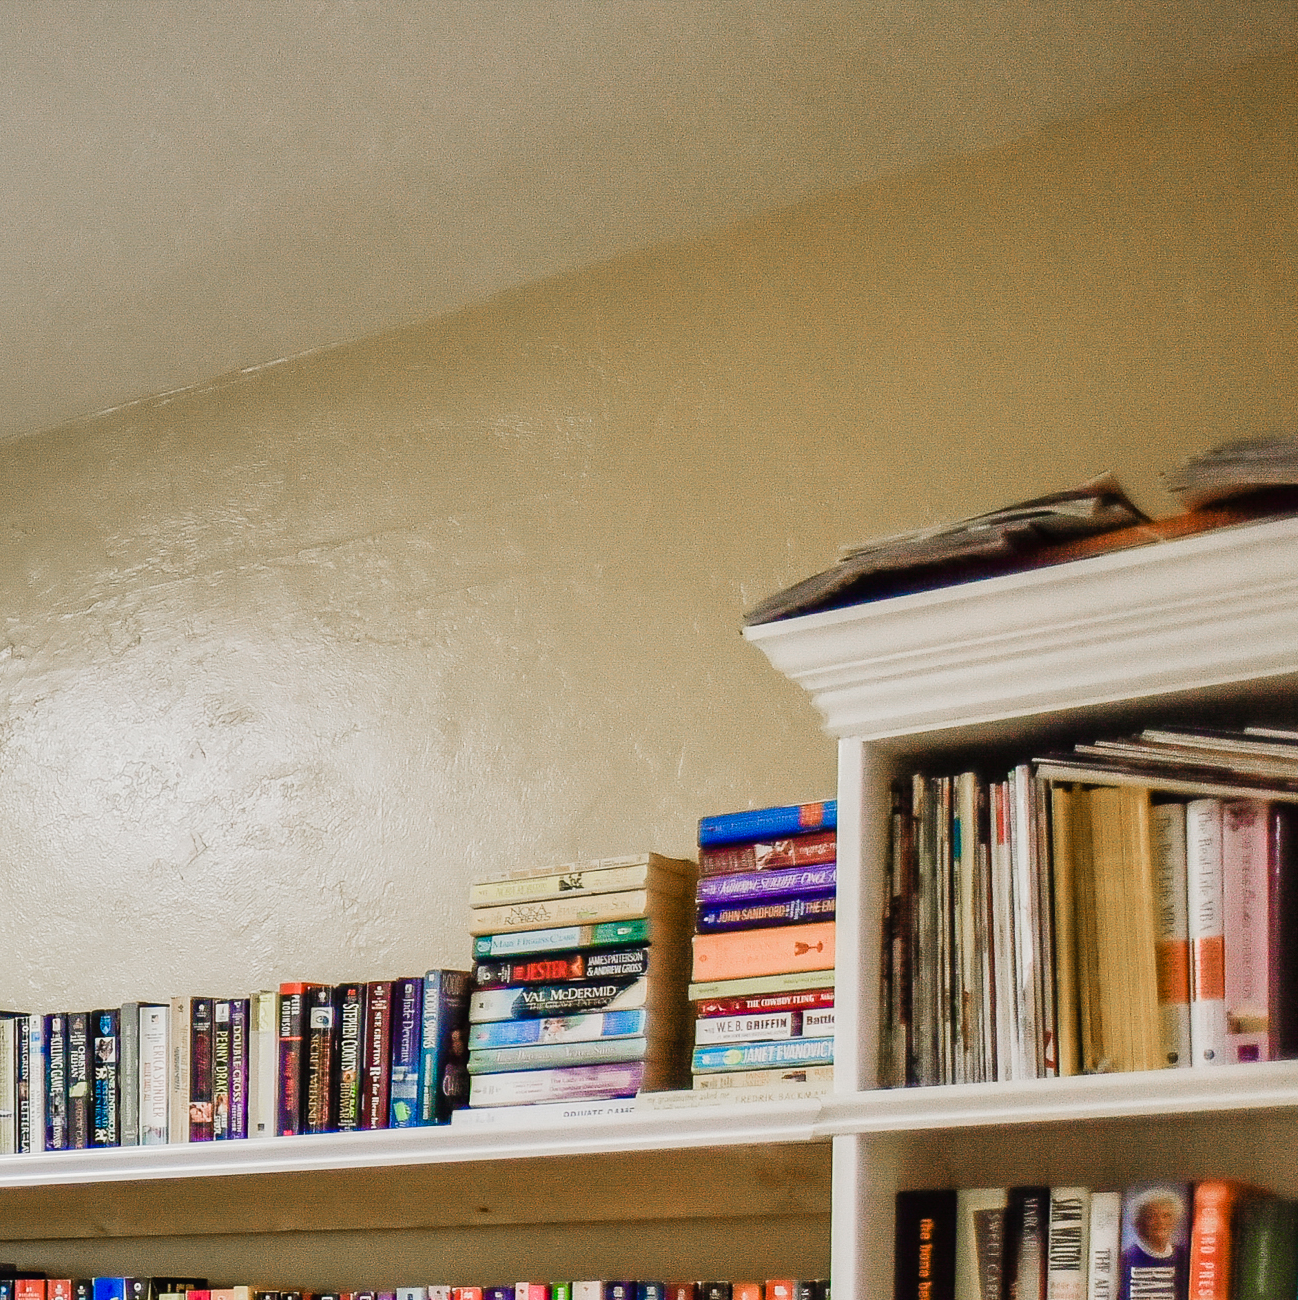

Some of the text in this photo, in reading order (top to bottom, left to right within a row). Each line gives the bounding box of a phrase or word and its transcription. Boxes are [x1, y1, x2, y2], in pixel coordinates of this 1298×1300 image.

[522, 986, 617, 1003] VAL McDERMID
[340, 1003, 360, 1071] STEPHEN COONTS
[373, 1011, 382, 1065] SUE GRAFTON
[401, 999, 414, 1063] Jude Deveraux
[746, 1017, 788, 1030] GRIFFIN
[51, 1037, 63, 1092] KILLING GAME
[153, 1045, 165, 1118] ERICA SPINDLER
[215, 1031, 229, 1096] PENNY DRAKE
[232, 1025, 242, 1103] DOUBLE CROSS
[919, 1218, 934, 1240] the
[986, 1213, 1000, 1257] SWEET
[1049, 1197, 1082, 1272] SAM WALTON
[918, 1243, 933, 1278] bone
[1094, 1248, 1112, 1274] THE
